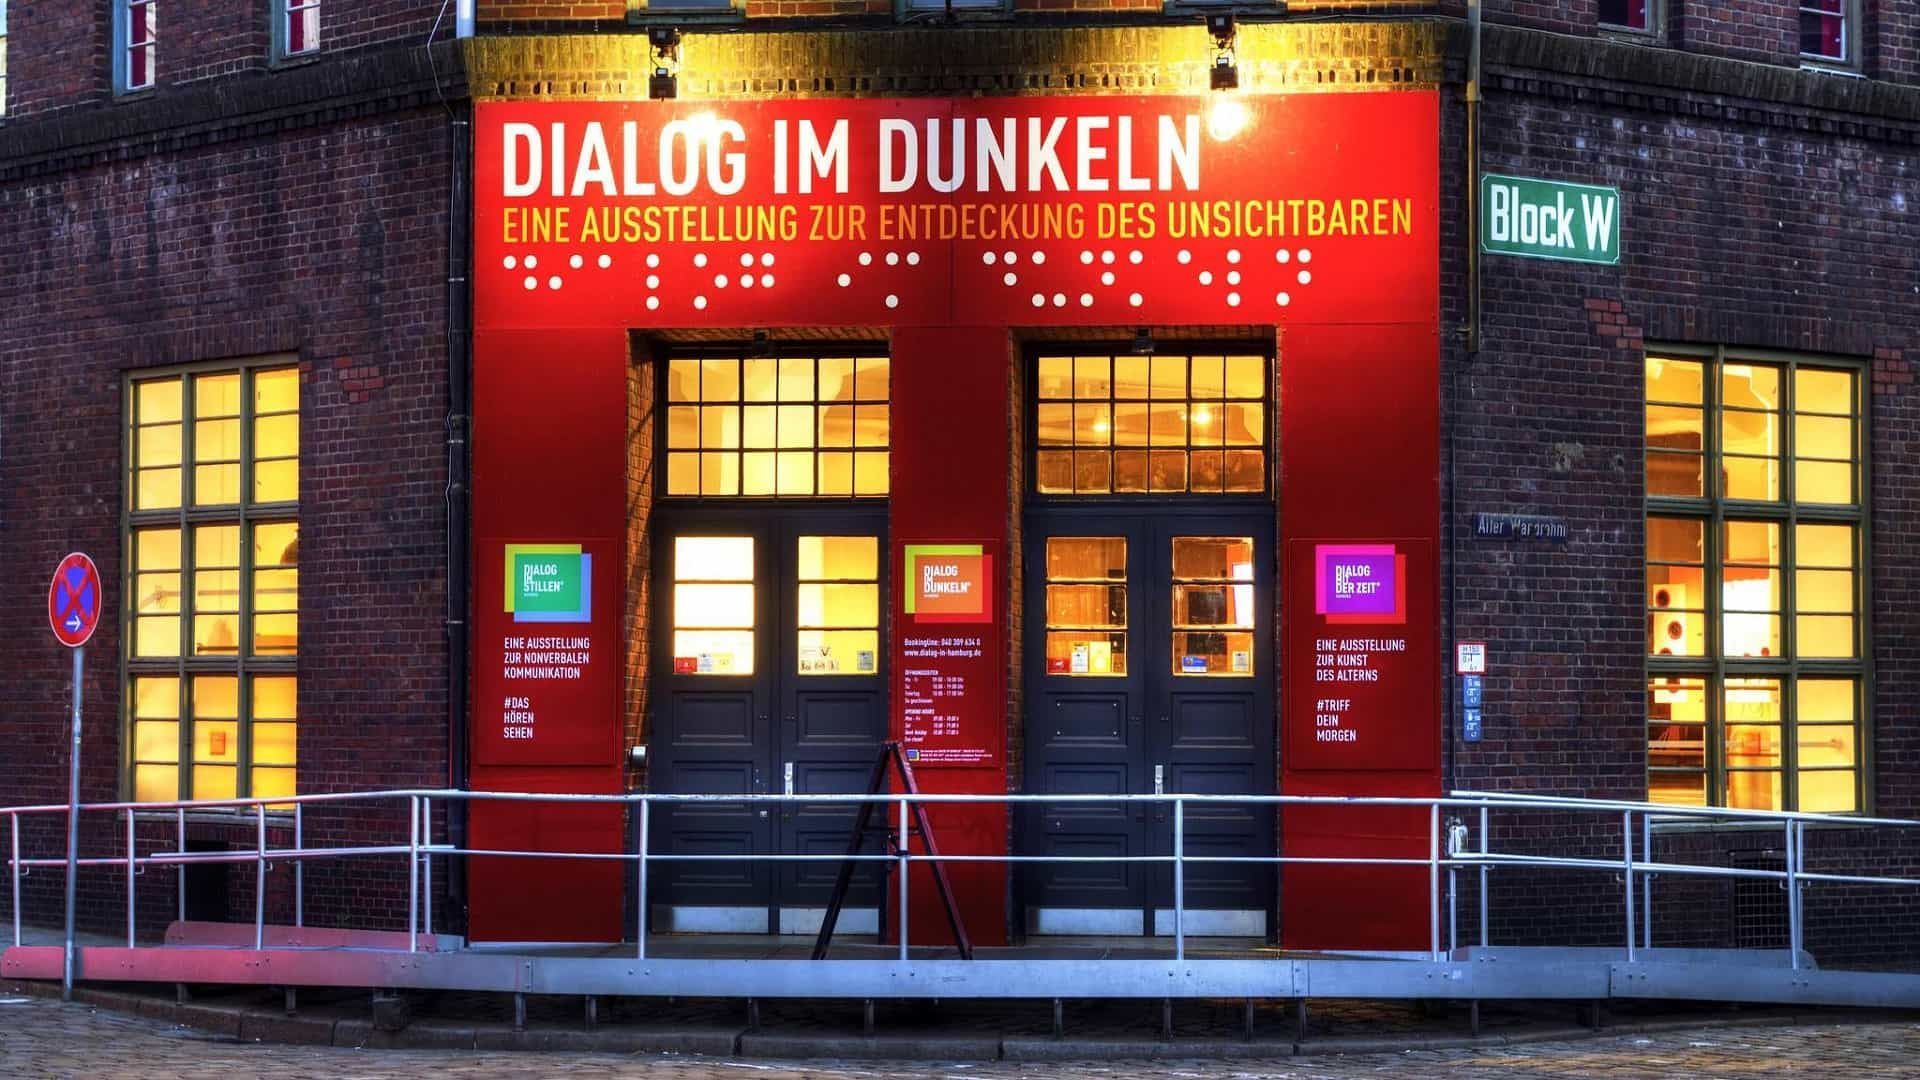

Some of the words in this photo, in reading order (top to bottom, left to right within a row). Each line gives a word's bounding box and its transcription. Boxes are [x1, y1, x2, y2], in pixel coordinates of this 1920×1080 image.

[504, 119, 746, 197] DIALOG
[774, 120, 848, 194] IM
[880, 114, 1200, 193] DUNKELN
[504, 207, 569, 243] EINE
[581, 206, 797, 243] AUSSTELLUNG
[809, 205, 866, 241] ZUR
[880, 203, 1084, 240] ENTDECKUNG
[1098, 202, 1155, 239] DES
[1168, 199, 1411, 239] UNSICHTBAREN
[1491, 183, 1574, 249] Block
[1581, 193, 1615, 252] W
[523, 564, 558, 576] DIALOG
[923, 565, 958, 577] DIALOG
[1335, 565, 1370, 577] DIALOG
[1335, 582, 1355, 594] DER
[504, 637, 525, 649] EINE
[527, 637, 590, 650] AUSSTELLUNG
[1316, 639, 1337, 651] EINE
[1339, 639, 1406, 652] AUSSTELLUNG
[504, 651, 522, 664] ZUR
[524, 651, 590, 664] NONVERBALEN
[1316, 654, 1335, 666] ZUR
[1337, 654, 1368, 666] KUNST
[504, 667, 581, 680] KOMMUNIKATION
[1316, 669, 1335, 681] DES
[1337, 669, 1379, 682] ALTERNS
[504, 697, 530, 709] #DAS
[1316, 699, 1351, 712] #TRIFF
[504, 709, 534, 724] HÖREN
[1316, 714, 1339, 727] DEIN
[504, 726, 533, 739] SEHEN
[1316, 729, 1357, 742] MORGEN
